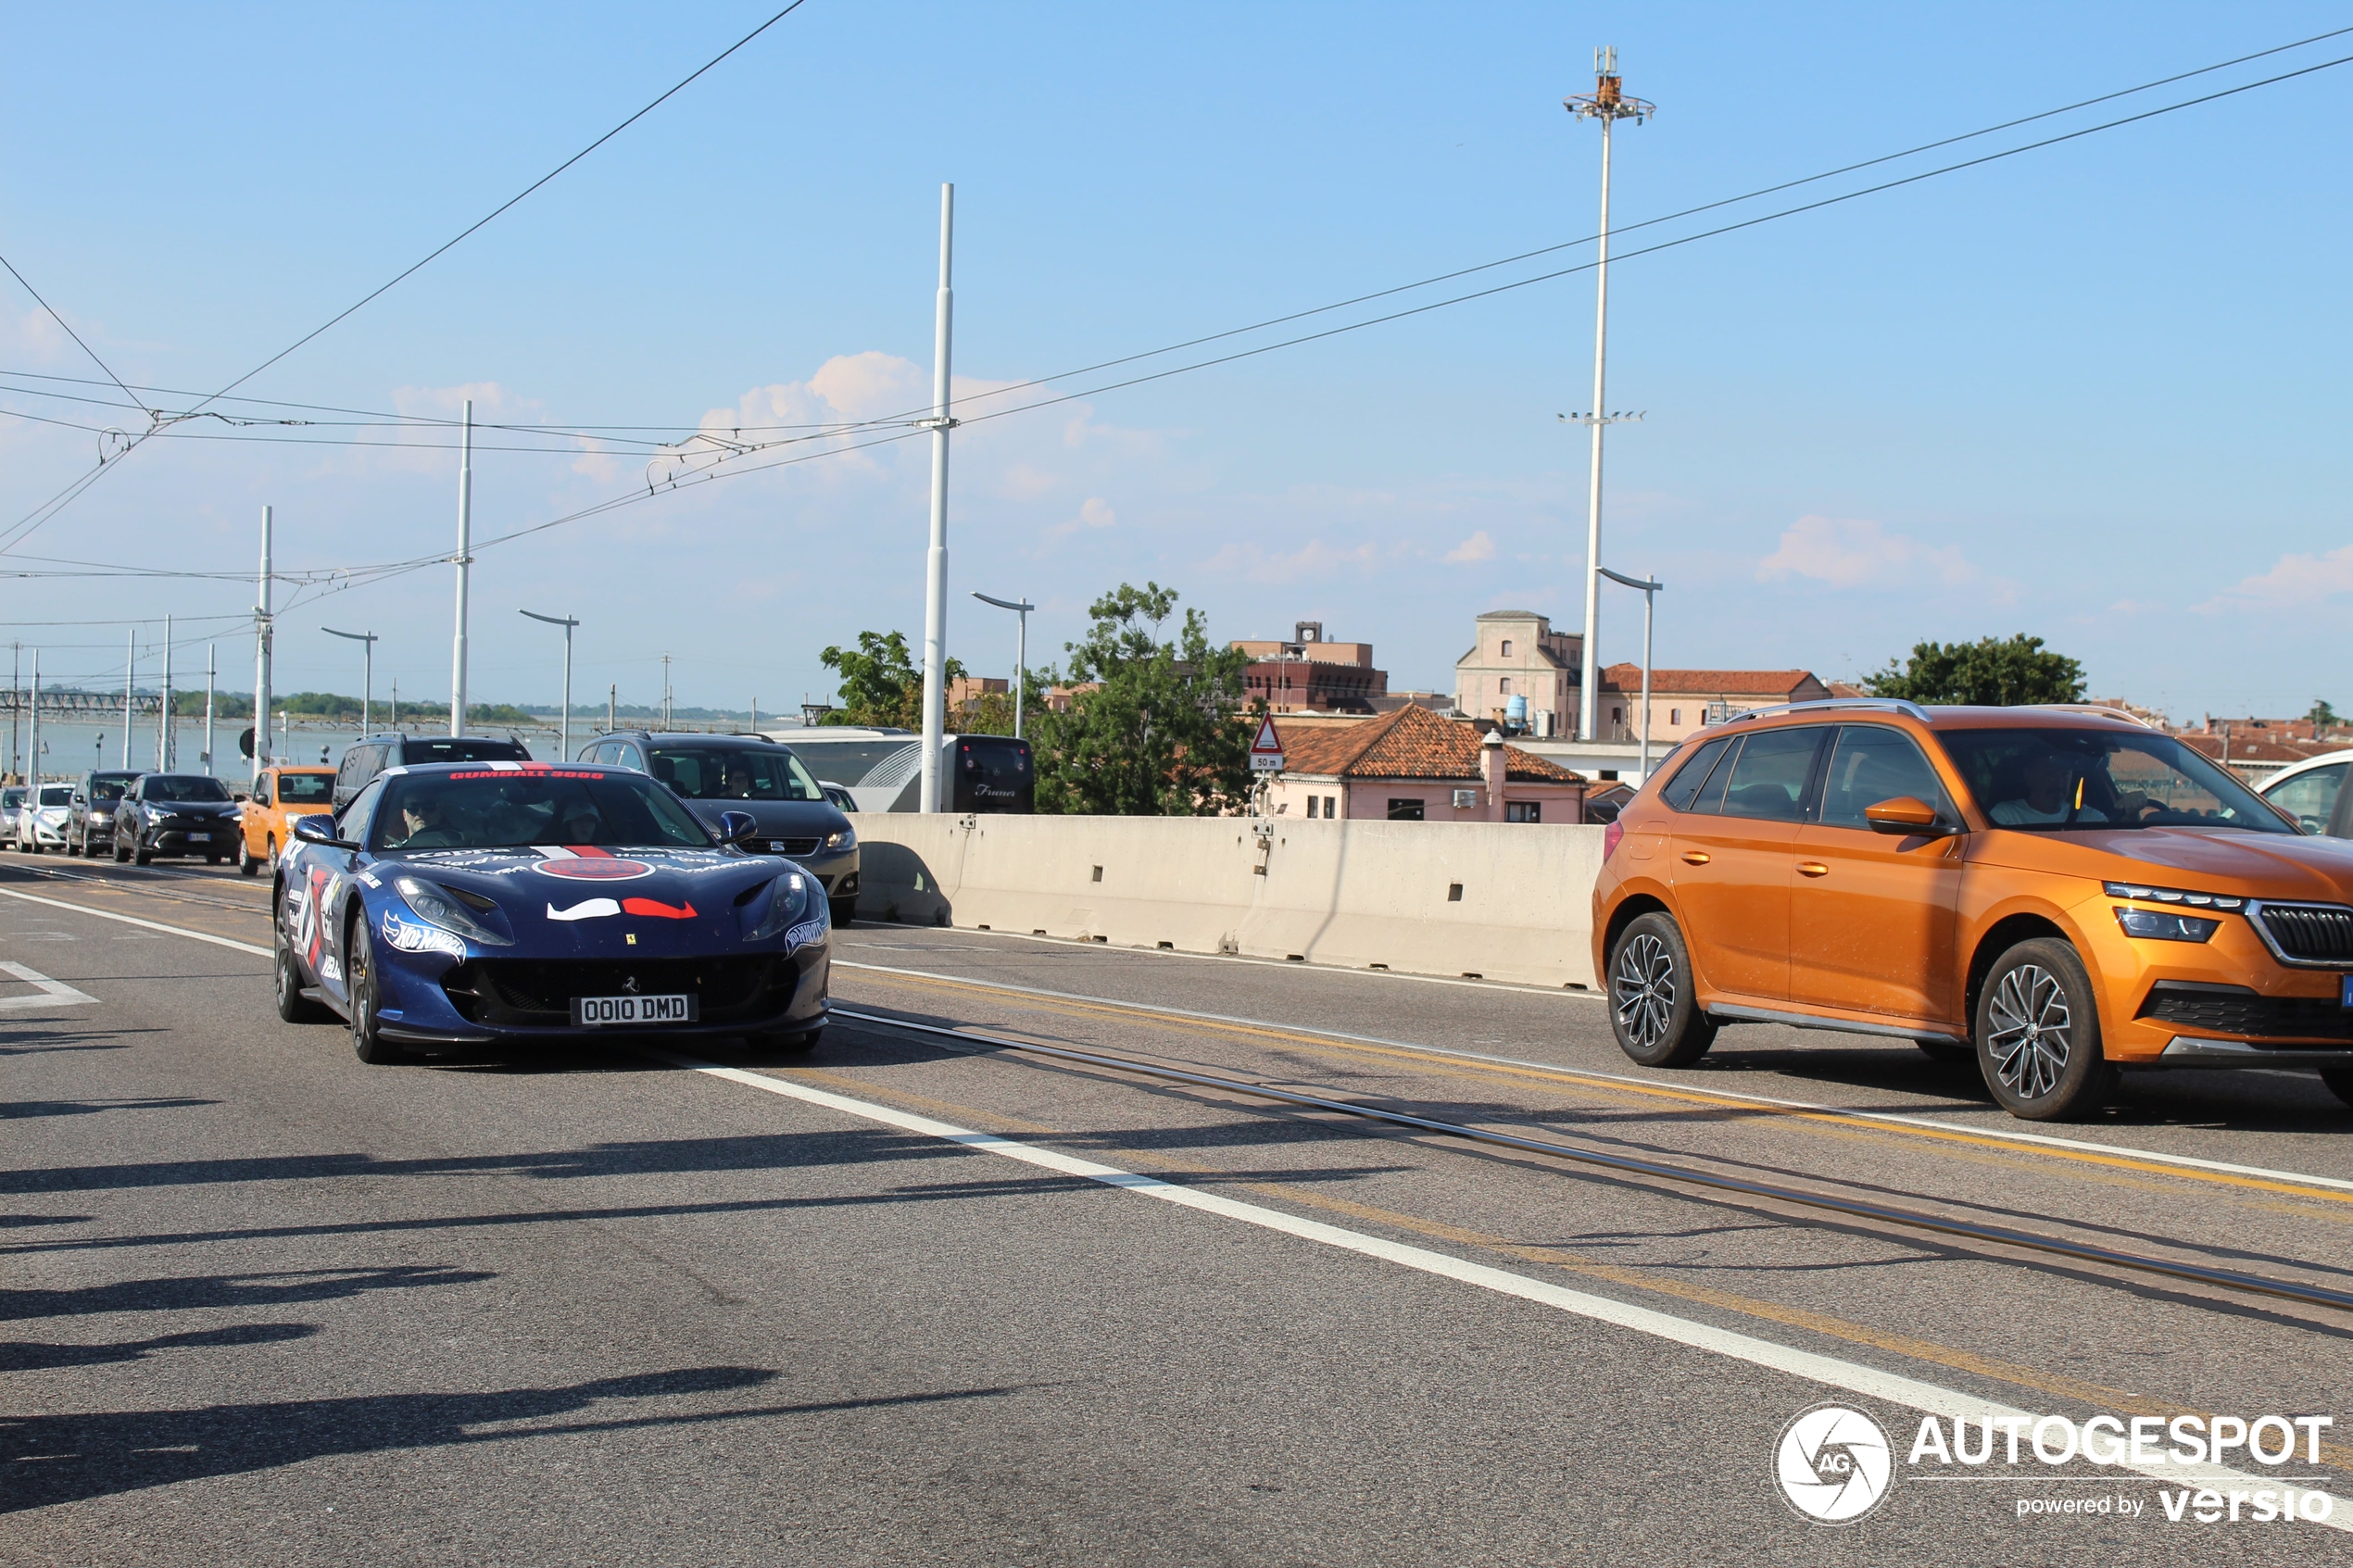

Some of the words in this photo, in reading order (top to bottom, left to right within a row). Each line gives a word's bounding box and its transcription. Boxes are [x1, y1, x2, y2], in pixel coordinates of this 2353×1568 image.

[1257, 758, 1267, 767] 50
[449, 770, 547, 780] GUMBALL
[550, 771, 605, 780] 3000
[404, 847, 512, 860] Kappa
[669, 854, 718, 864] Rock
[641, 997, 685, 1020] DMD
